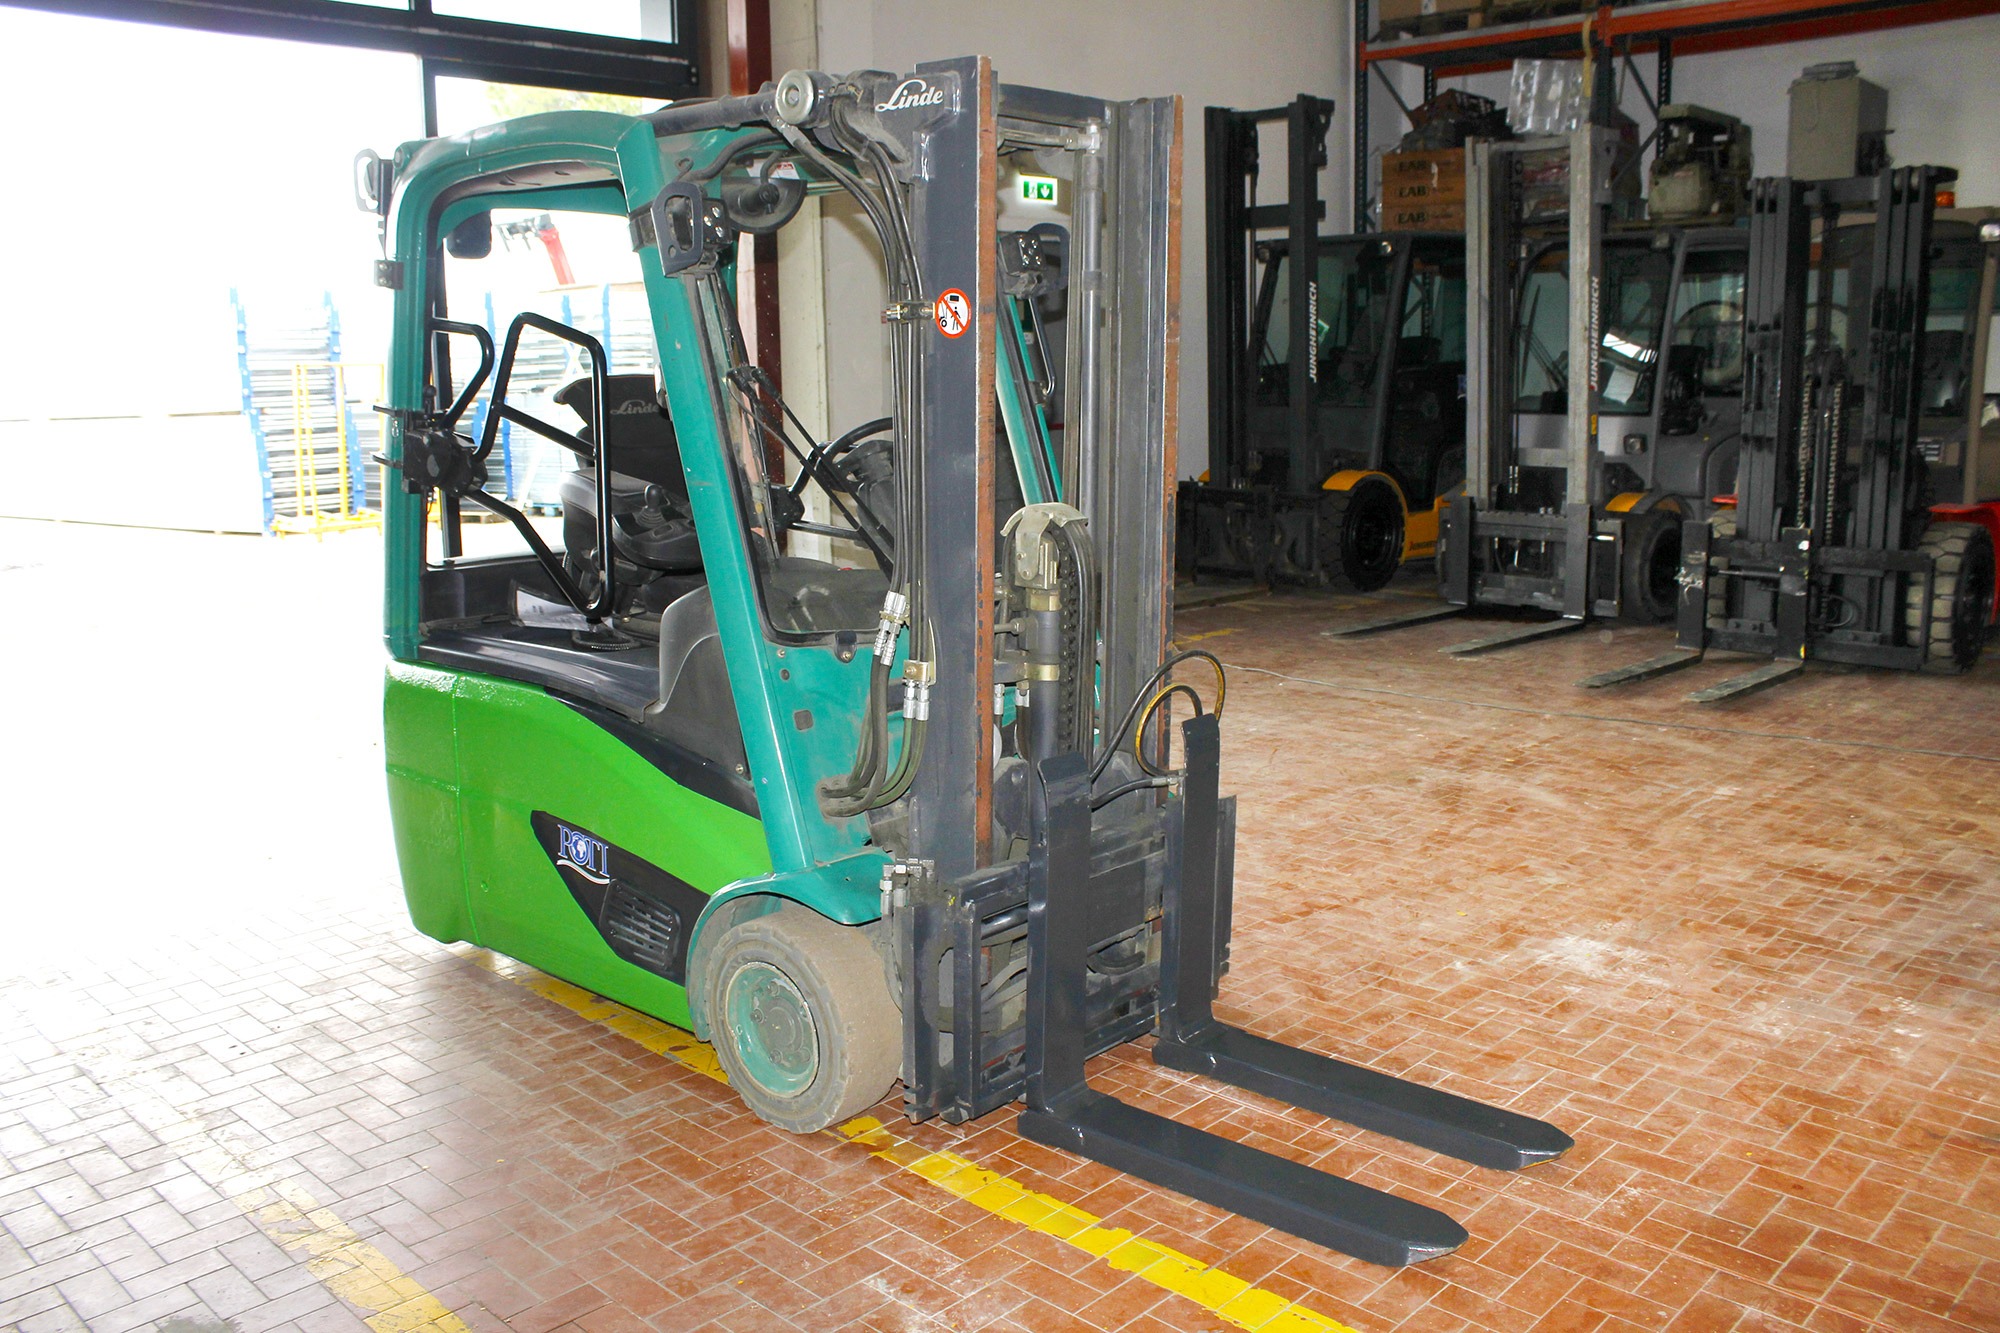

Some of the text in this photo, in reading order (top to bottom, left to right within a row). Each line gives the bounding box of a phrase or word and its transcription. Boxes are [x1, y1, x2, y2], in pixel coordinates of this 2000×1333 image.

[875, 79, 944, 112] Linde
[1308, 281, 1317, 383] JUNGHEINRICH
[1590, 276, 1599, 392] JUNGHEINRICH
[610, 399, 660, 415] Linde
[557, 824, 610, 878] POTI
